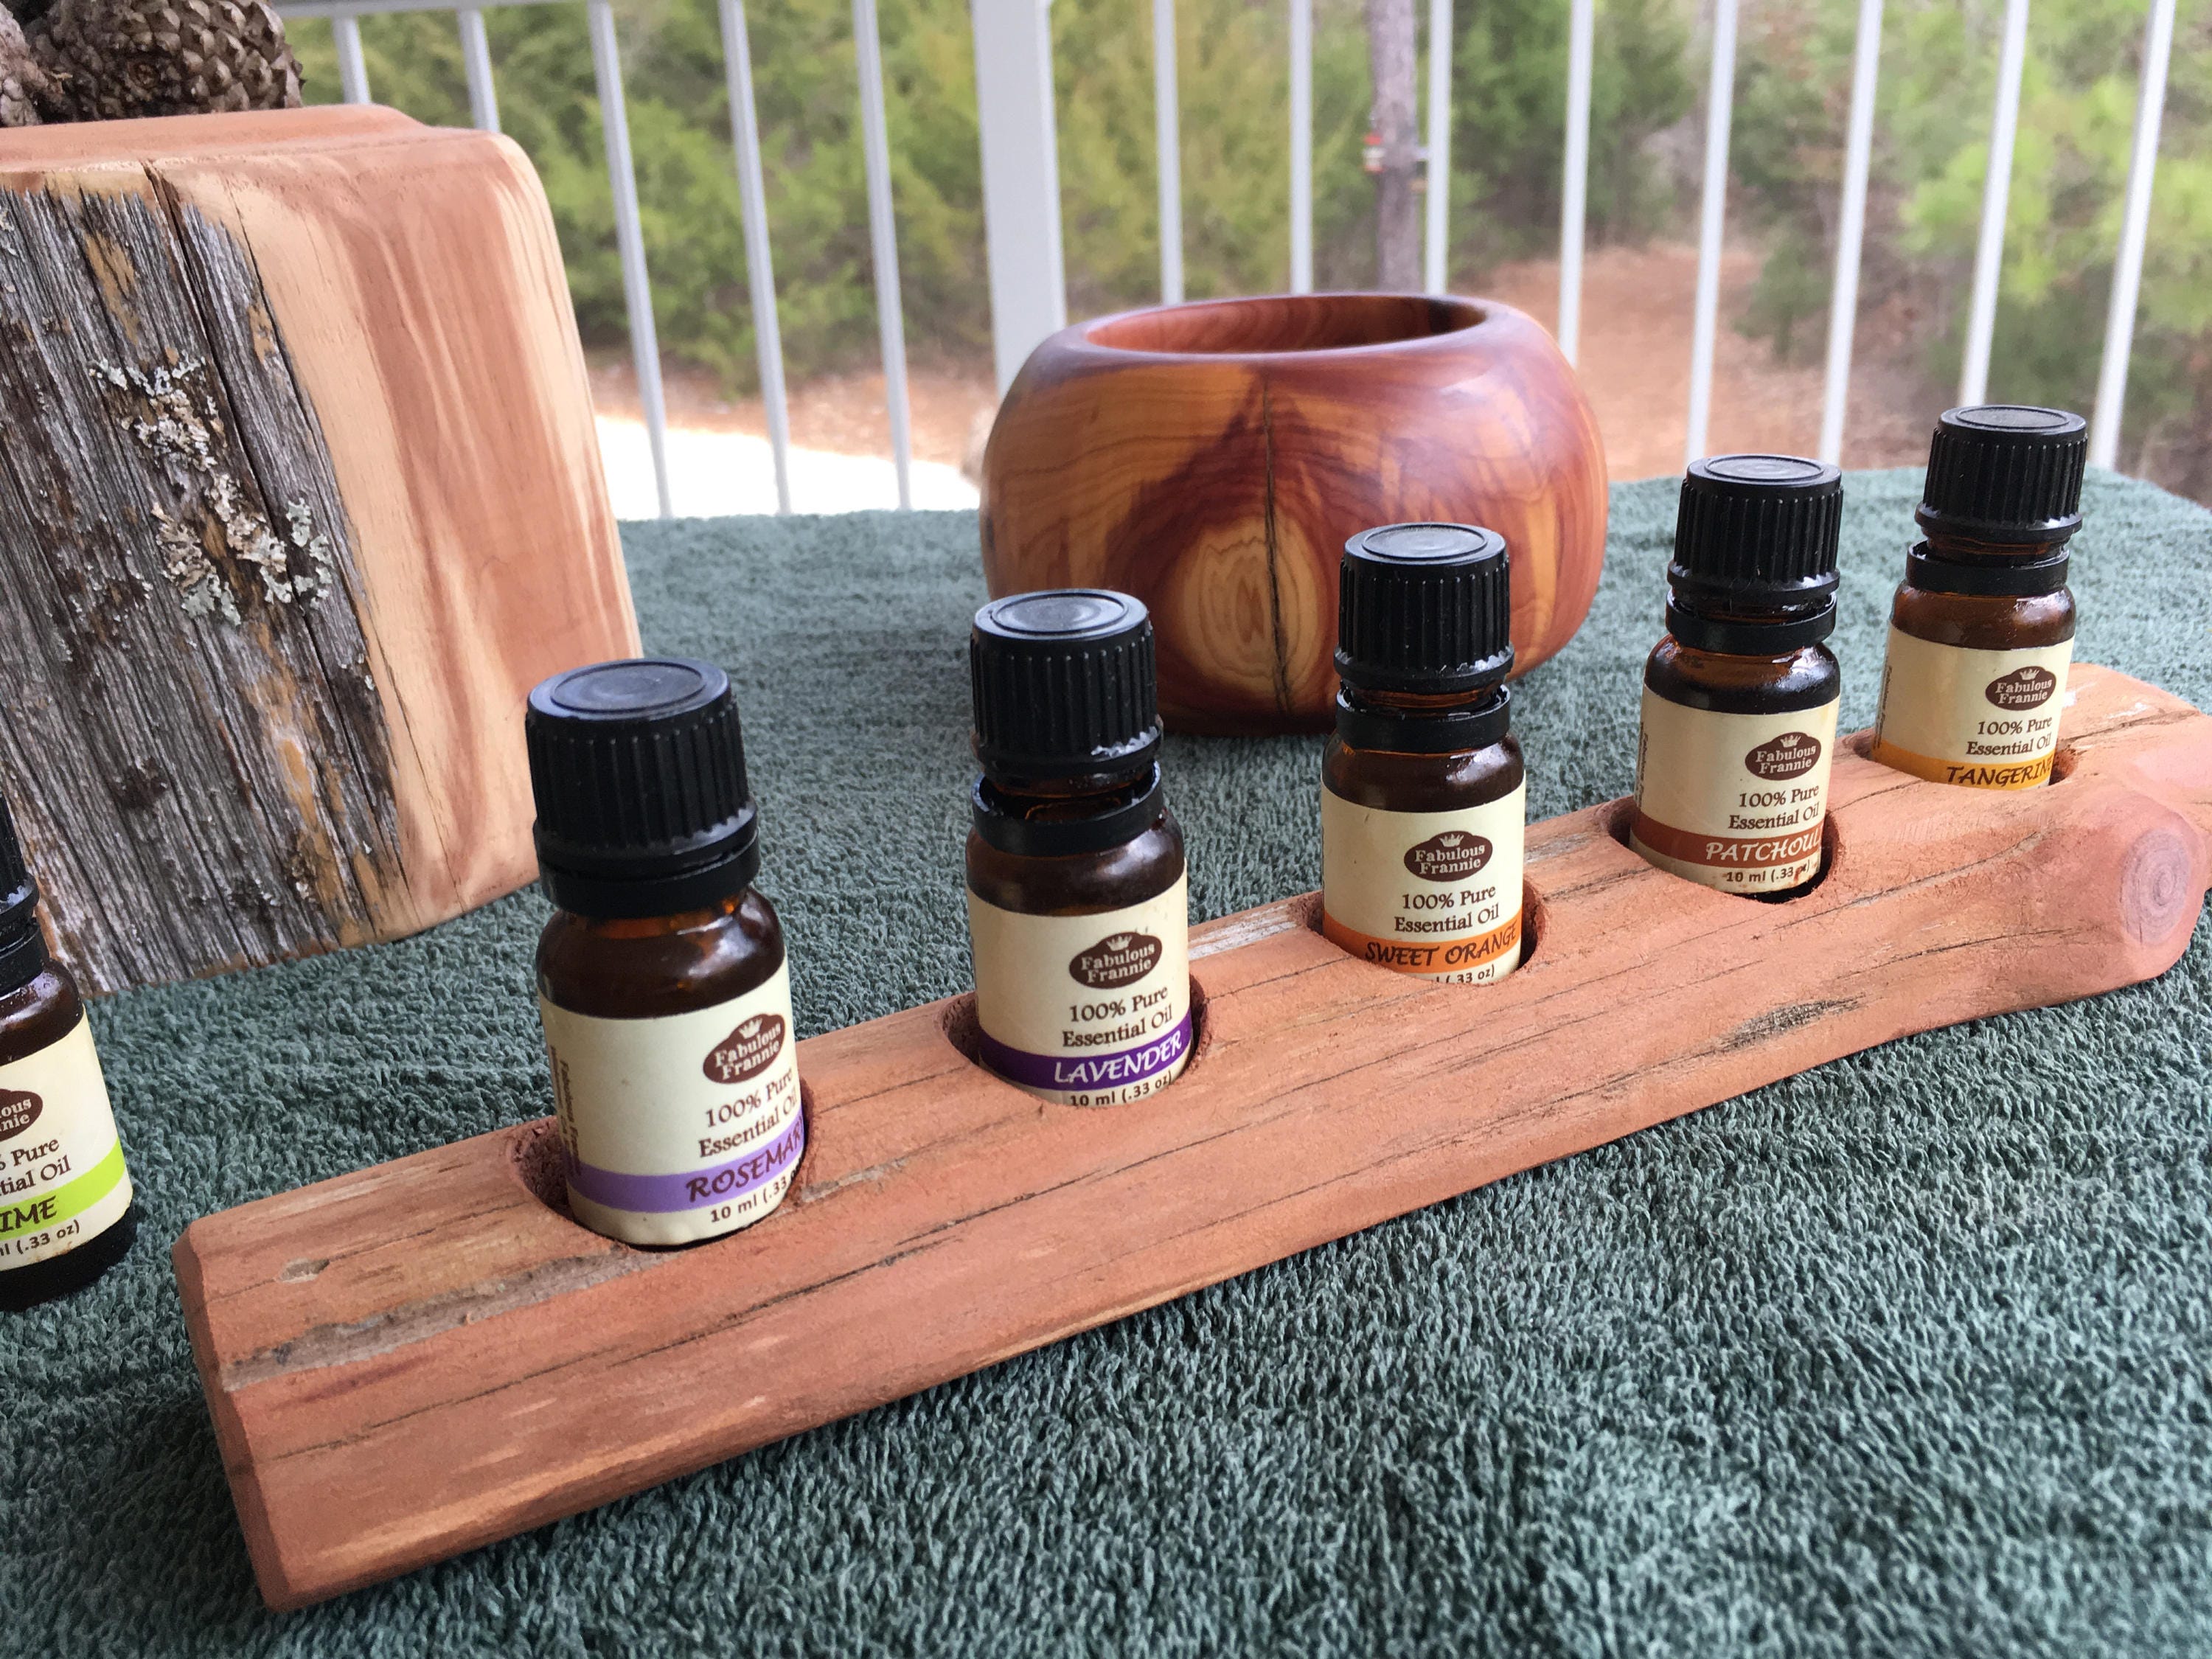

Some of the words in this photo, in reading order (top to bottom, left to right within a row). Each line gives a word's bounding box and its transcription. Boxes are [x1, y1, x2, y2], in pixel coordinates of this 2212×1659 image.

[1995, 679, 2053, 694] Fabulous
[1997, 691, 2048, 704] Frannie
[1978, 720, 2023, 735] 100%
[2026, 717, 2053, 733] Pure
[1756, 745, 1816, 763] Fabulous
[1966, 738, 2034, 756] Essential
[2037, 731, 2051, 750] Oil
[1759, 758, 1812, 774] Frannie
[1739, 790, 1787, 807] 100%
[1790, 785, 1820, 804] Pure
[1728, 810, 1799, 830] Essential
[1803, 801, 1820, 821] Oil
[1414, 845, 1485, 863] Fabulous
[1419, 858, 1481, 875] Frannie
[1726, 871, 1743, 882] 10
[1748, 870, 1766, 882] ml
[1771, 866, 1794, 882] (.33
[1402, 893, 1455, 910] 100%
[1460, 886, 1496, 906] Pure
[1394, 911, 1473, 933] Essential
[1478, 902, 1499, 924] Oil
[1081, 943, 1155, 971] Fabulous
[1365, 942, 1440, 967] SWEET
[1444, 921, 1517, 965] ORANGE
[1088, 959, 1152, 984] Frannie
[1478, 964, 1495, 980] oz)
[1070, 999, 1126, 1023] 100%
[1132, 986, 1168, 1012] Pure
[1062, 1018, 1146, 1048] Essential
[1152, 1004, 1173, 1028] Oil
[714, 1022, 782, 1068] Fabulous
[1054, 1030, 1182, 1084] LAVENDER
[722, 1039, 780, 1081] Frannie
[706, 1089, 762, 1128] 100%
[766, 1068, 793, 1102] Pure
[1070, 1094, 1089, 1107] 10
[1096, 1091, 1115, 1105] ml
[1121, 1082, 1150, 1104] (.33
[1155, 1070, 1173, 1089] oz)
[0, 1098, 32, 1118] ous
[698, 1107, 780, 1158] Essential
[784, 1085, 798, 1116] Oil
[0, 1114, 30, 1132] nie
[11, 1138, 60, 1166] Pure
[0, 1170, 36, 1197] tial
[41, 1155, 72, 1181] Oil
[0, 1195, 58, 1232] IME
[710, 1205, 732, 1223] 10
[737, 1193, 757, 1214] ml
[762, 1177, 787, 1204] (.33
[16, 1232, 50, 1255] (.33
[57, 1219, 80, 1239] oz)
